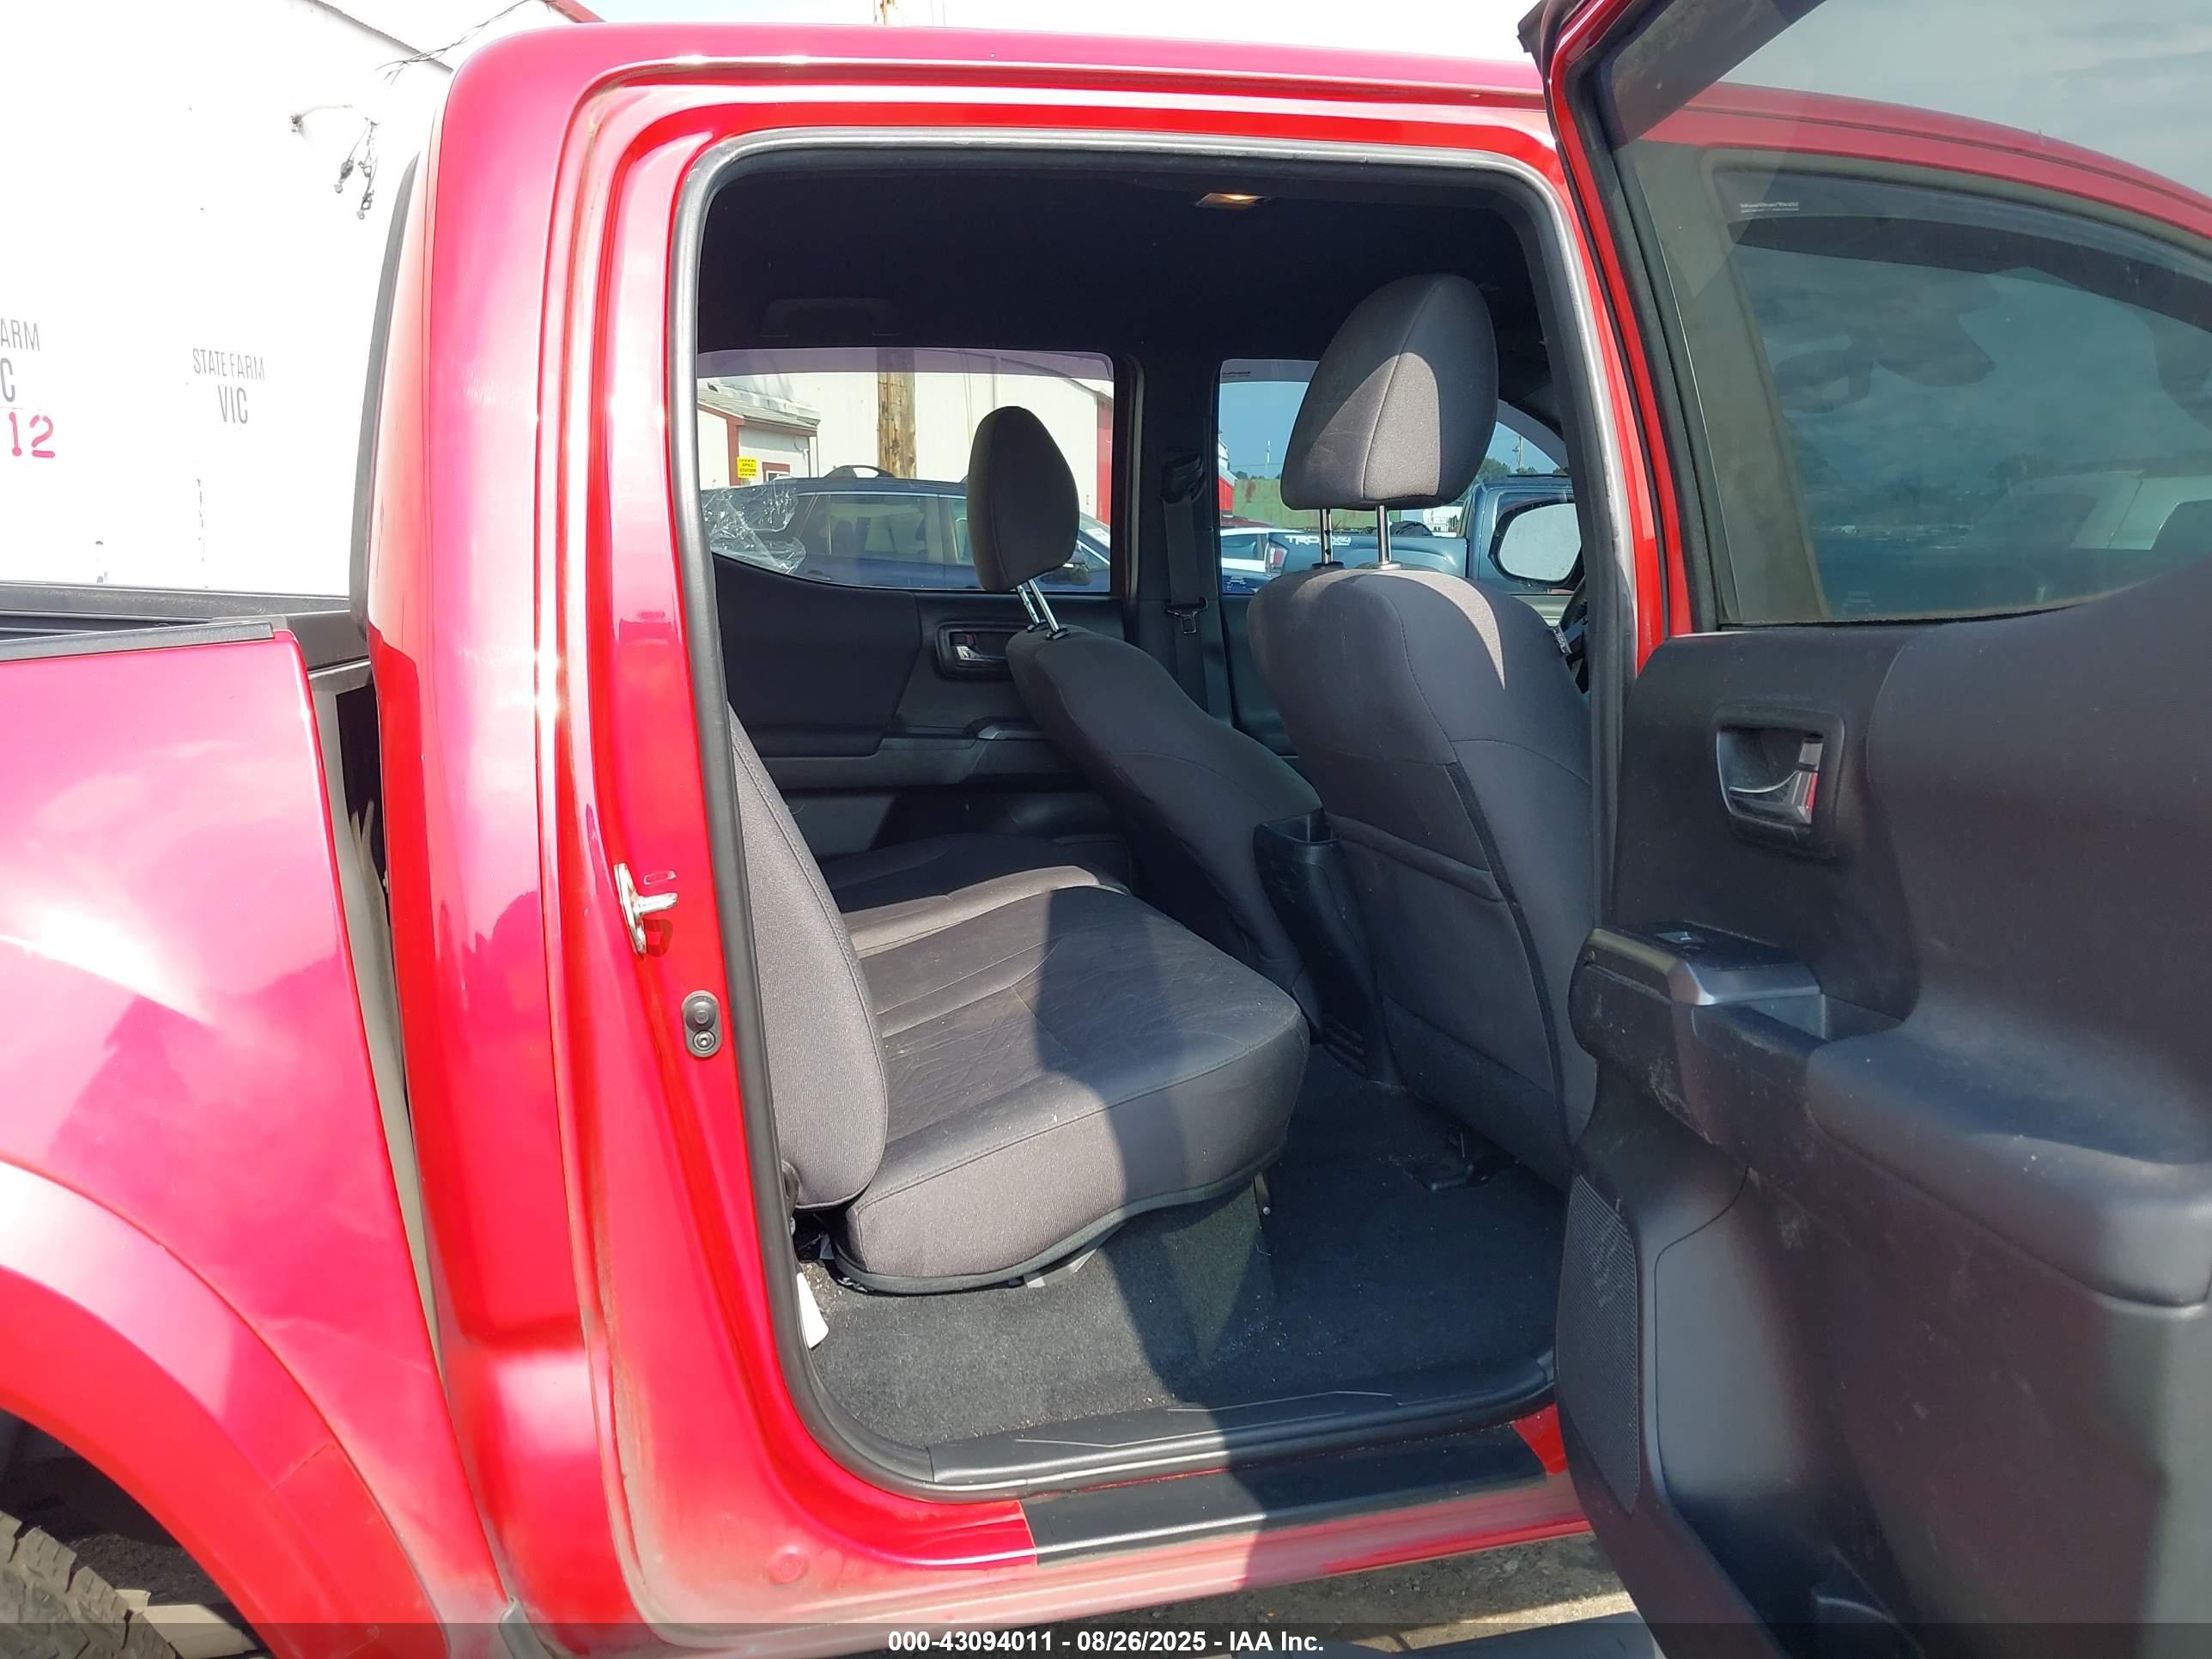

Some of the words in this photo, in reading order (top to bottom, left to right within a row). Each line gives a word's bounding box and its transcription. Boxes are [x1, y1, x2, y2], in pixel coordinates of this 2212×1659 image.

[192, 348, 228, 376] STATE
[229, 353, 265, 380] FARM
[217, 384, 248, 424] VIC
[9, 411, 56, 458] 12
